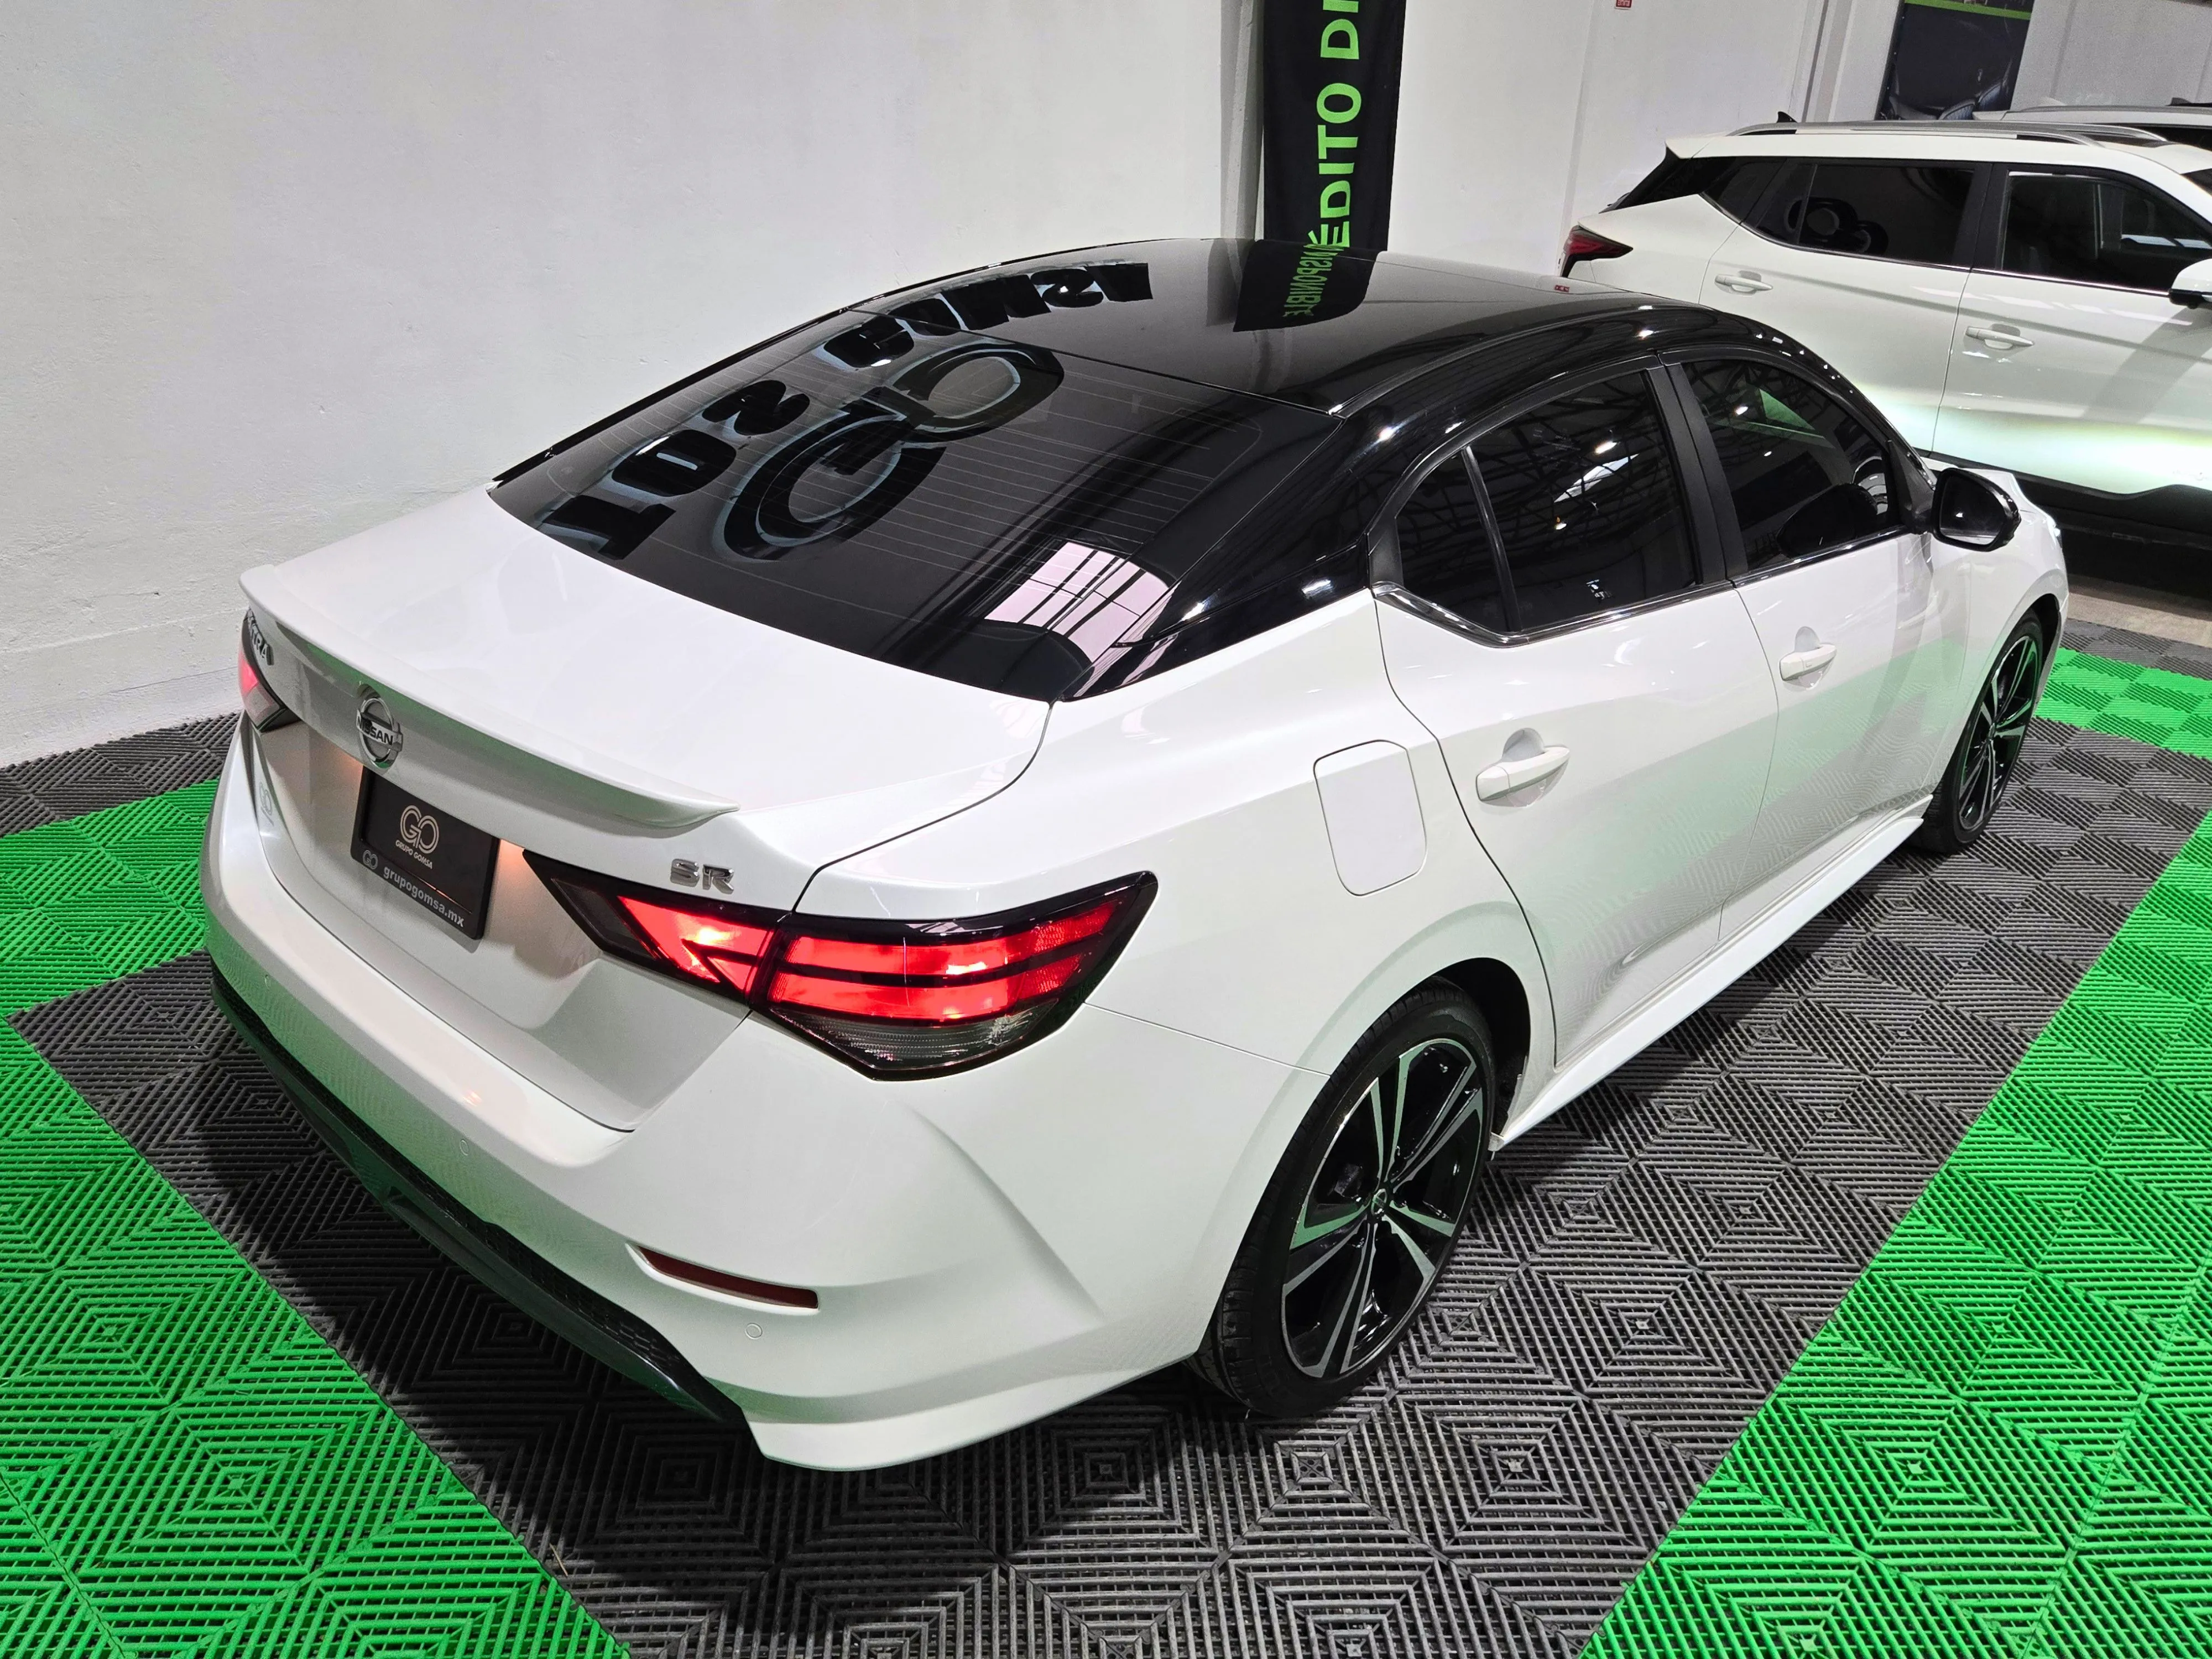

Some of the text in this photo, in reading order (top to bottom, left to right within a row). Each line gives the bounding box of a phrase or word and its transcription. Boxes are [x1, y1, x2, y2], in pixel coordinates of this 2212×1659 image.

[395, 839, 433, 869] GRUPO GOMSA
[670, 858, 734, 895] SR
[383, 867, 465, 928] grupogomsa.mx
